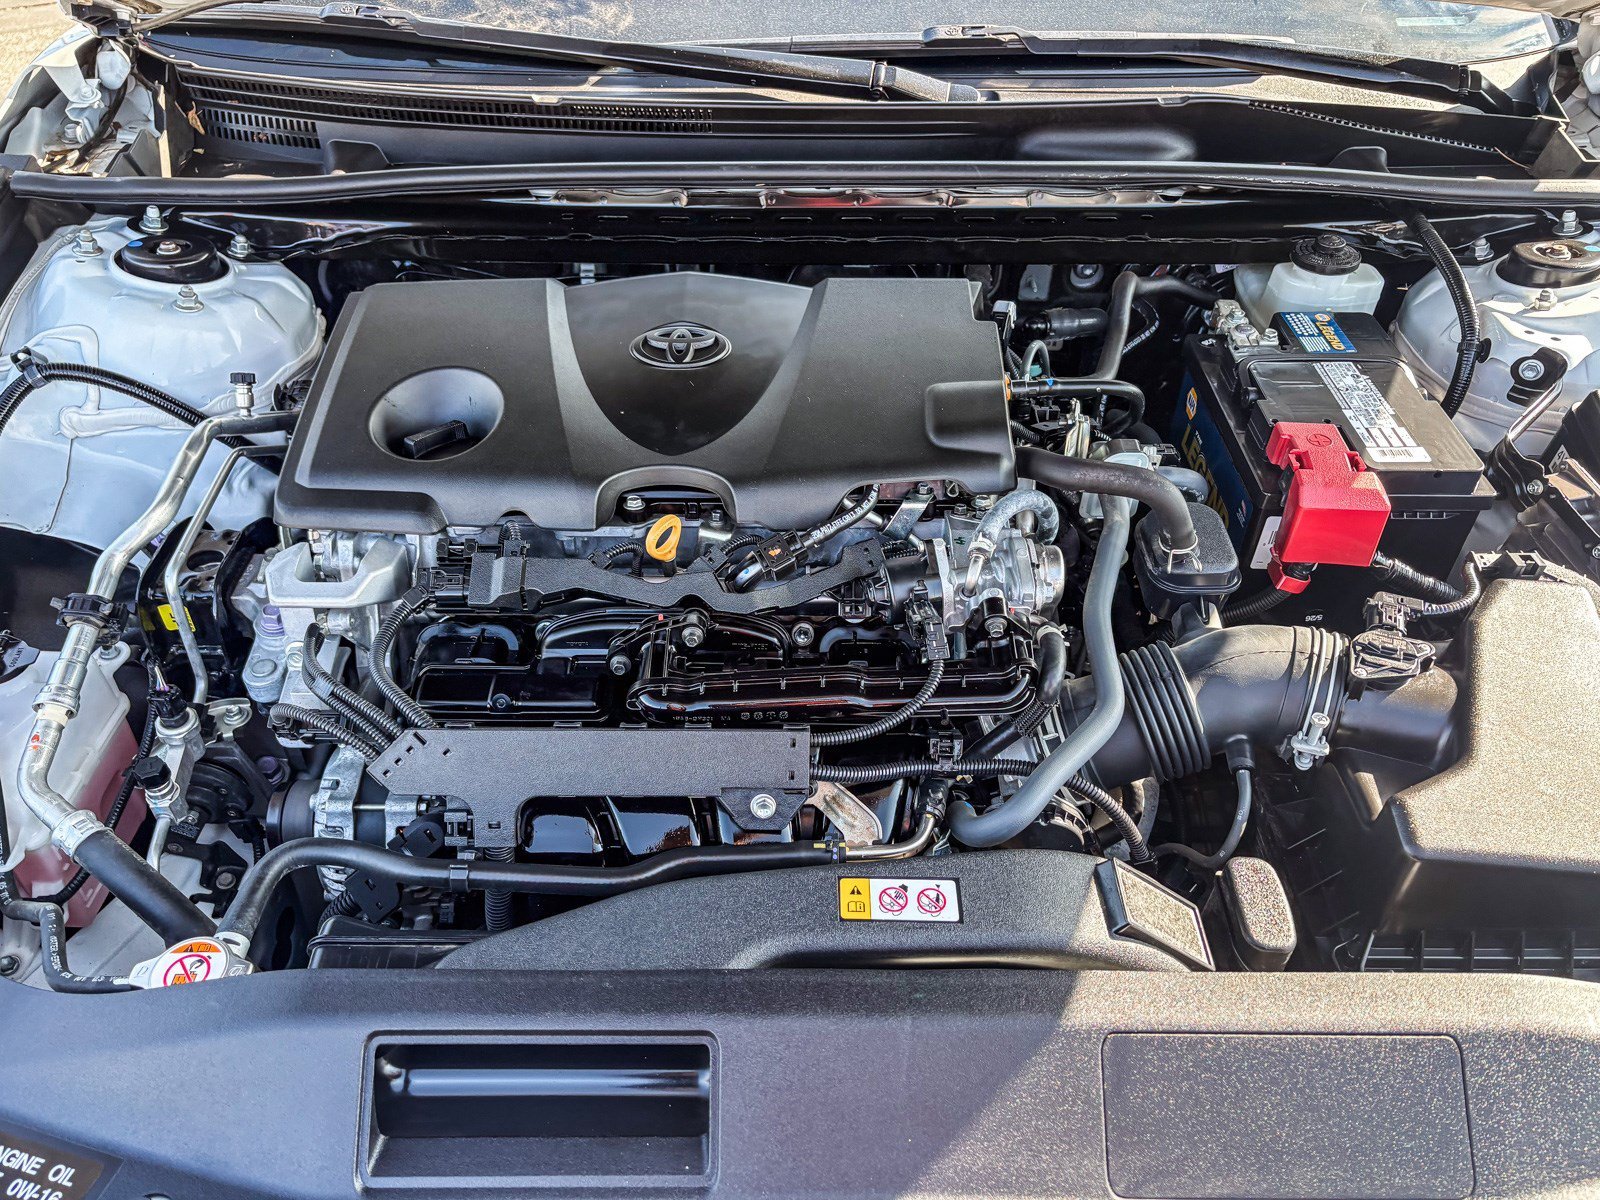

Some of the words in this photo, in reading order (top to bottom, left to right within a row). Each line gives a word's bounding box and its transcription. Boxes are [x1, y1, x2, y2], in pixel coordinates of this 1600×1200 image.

[1315, 321, 1346, 351] LEGEND
[1304, 614, 1324, 622] 5/26
[47, 1164, 76, 1188] OIL
[6, 1178, 64, 1200] 0W-16
